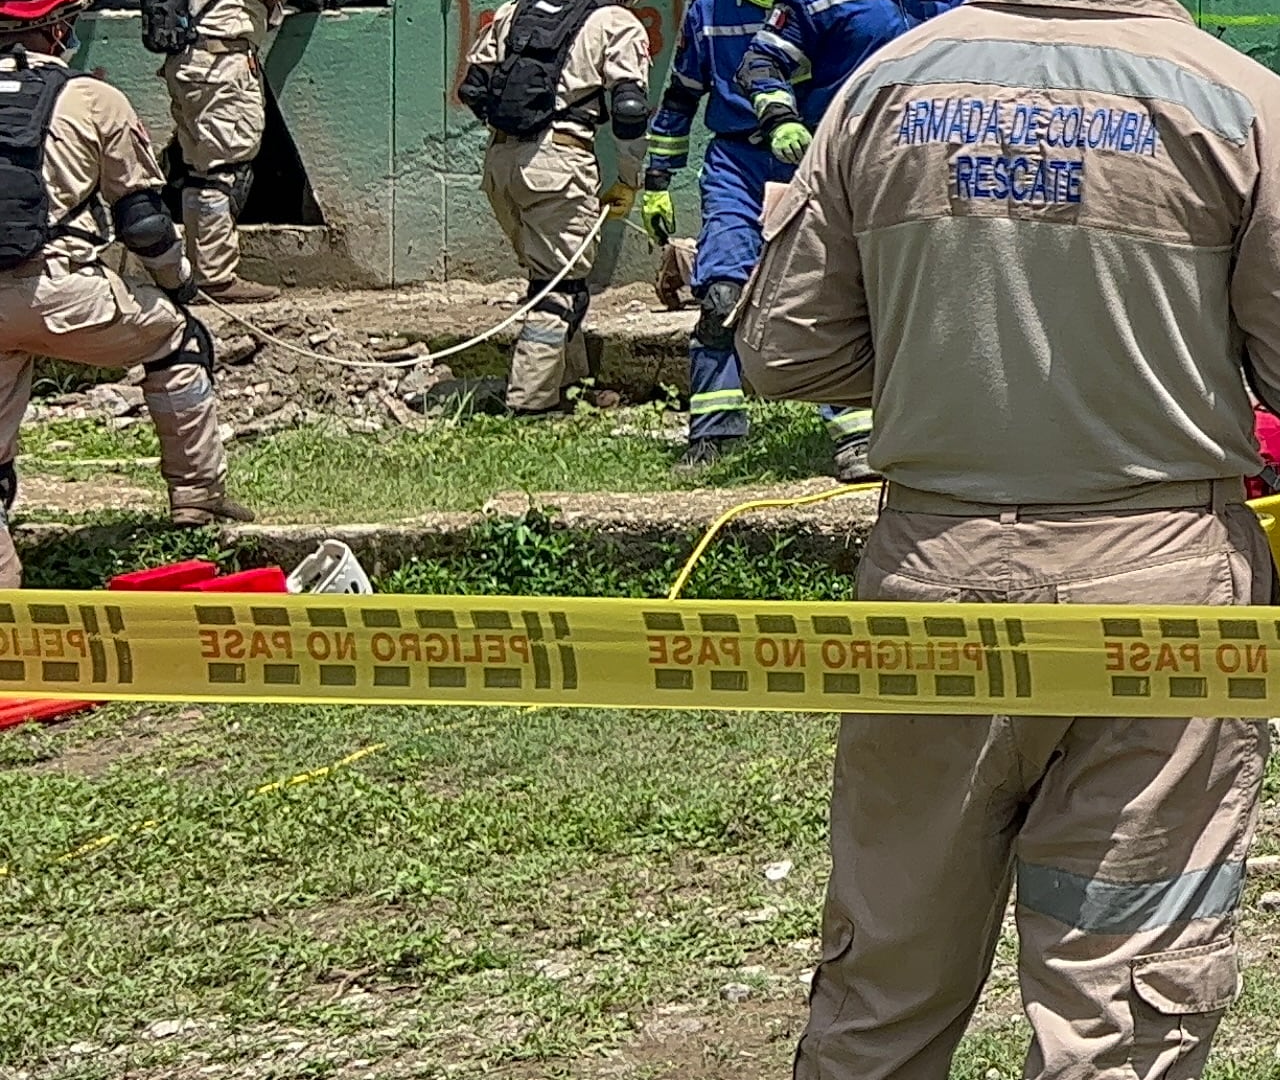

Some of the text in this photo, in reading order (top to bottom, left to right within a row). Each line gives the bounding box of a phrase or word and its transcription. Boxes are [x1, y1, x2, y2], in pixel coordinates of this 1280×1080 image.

[900, 98, 1158, 158] ARMADA DE COLOMBIA
[956, 155, 1085, 204] RESCATE
